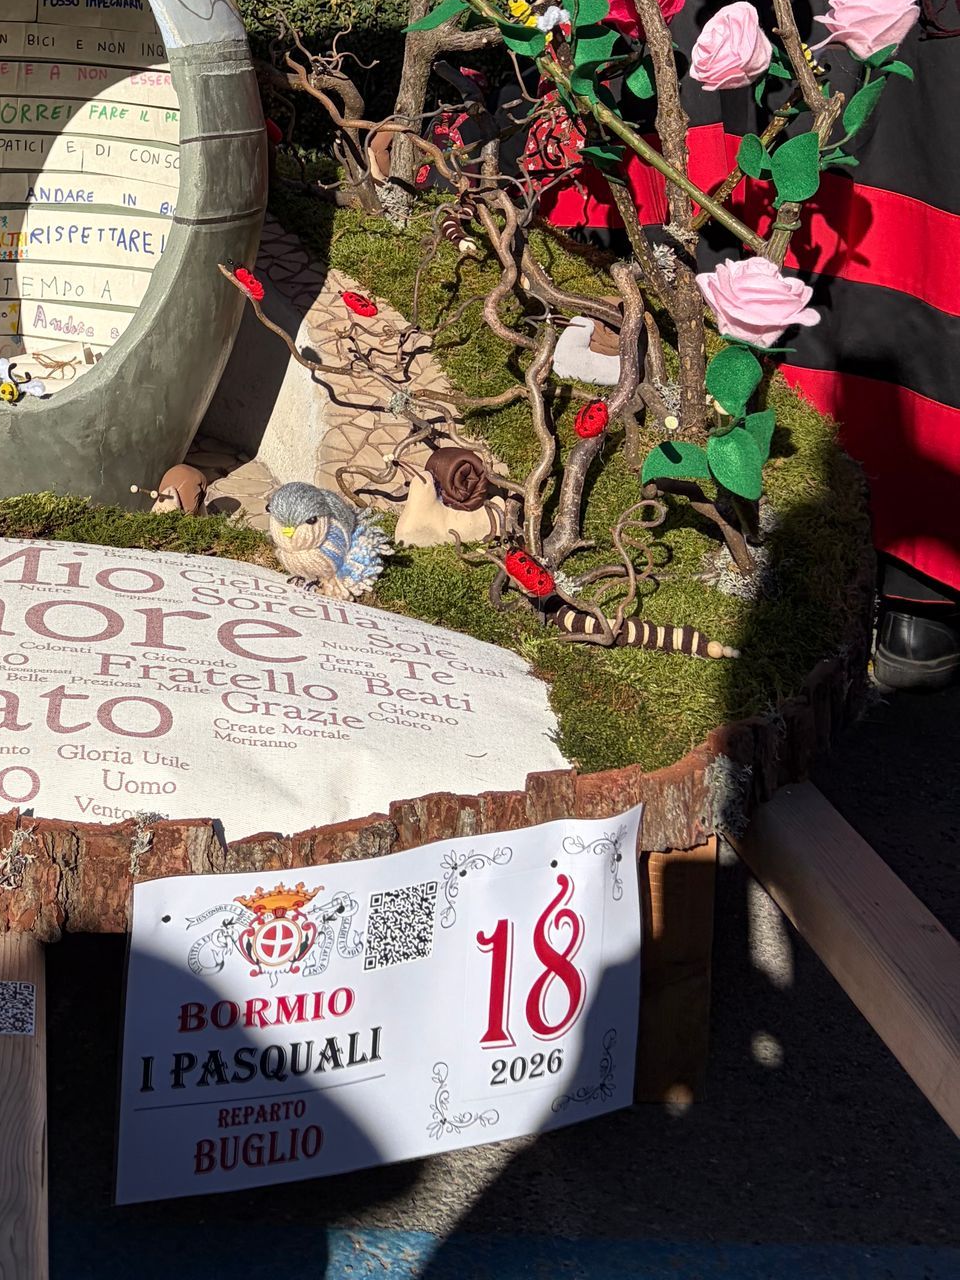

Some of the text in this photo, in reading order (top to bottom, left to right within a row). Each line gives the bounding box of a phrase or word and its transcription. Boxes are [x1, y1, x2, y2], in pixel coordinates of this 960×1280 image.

[27, 34, 55, 47] BICI
[76, 39, 84, 50] E
[97, 41, 126, 54] NON
[24, 64, 33, 76] E
[49, 65, 61, 81] A
[78, 67, 108, 81] NON
[89, 104, 130, 120] FARE
[140, 110, 150, 123] IL
[66, 141, 77, 153] E
[95, 144, 111, 158] DI
[25, 187, 95, 202] ANDARE
[123, 193, 137, 206] IN
[30, 225, 155, 255] RISPETTARE
[3, 275, 85, 298] TEMPO
[100, 279, 112, 301] A
[19, 583, 74, 595] Nutre
[179, 569, 288, 595] Cielo
[114, 592, 184, 604] Sopportano
[191, 586, 386, 632] Sorella
[19, 641, 93, 655] Colorati
[321, 640, 402, 658] Nuvoloso
[367, 633, 457, 660] Sole
[142, 651, 238, 670] Giocondo
[318, 653, 375, 669] Terra
[319, 662, 388, 680] Umano
[448, 660, 508, 679] Guai
[6, 671, 49, 684] Belle
[69, 675, 142, 689] Preziosa
[94, 651, 339, 703] Fratello
[390, 658, 457, 685] Te
[156, 682, 212, 696] Male
[364, 676, 475, 713] Beati
[220, 690, 366, 731] Grazie
[377, 701, 460, 726] Giorno
[213, 717, 276, 736] Create
[281, 723, 351, 741] Mortale
[367, 711, 433, 732] Coloro
[213, 731, 298, 750] Moriranno
[56, 743, 134, 766] Gloria
[141, 750, 191, 771] Utile
[101, 768, 177, 795] Uomo
[74, 795, 133, 821] Vento
[476, 873, 588, 1050] 18
[177, 986, 356, 1035] BORMIO
[139, 1025, 384, 1093] I PASQUALI
[488, 1048, 564, 1087] 2026
[216, 1099, 307, 1129] REPARTO
[193, 1123, 325, 1176] BUGLIO
